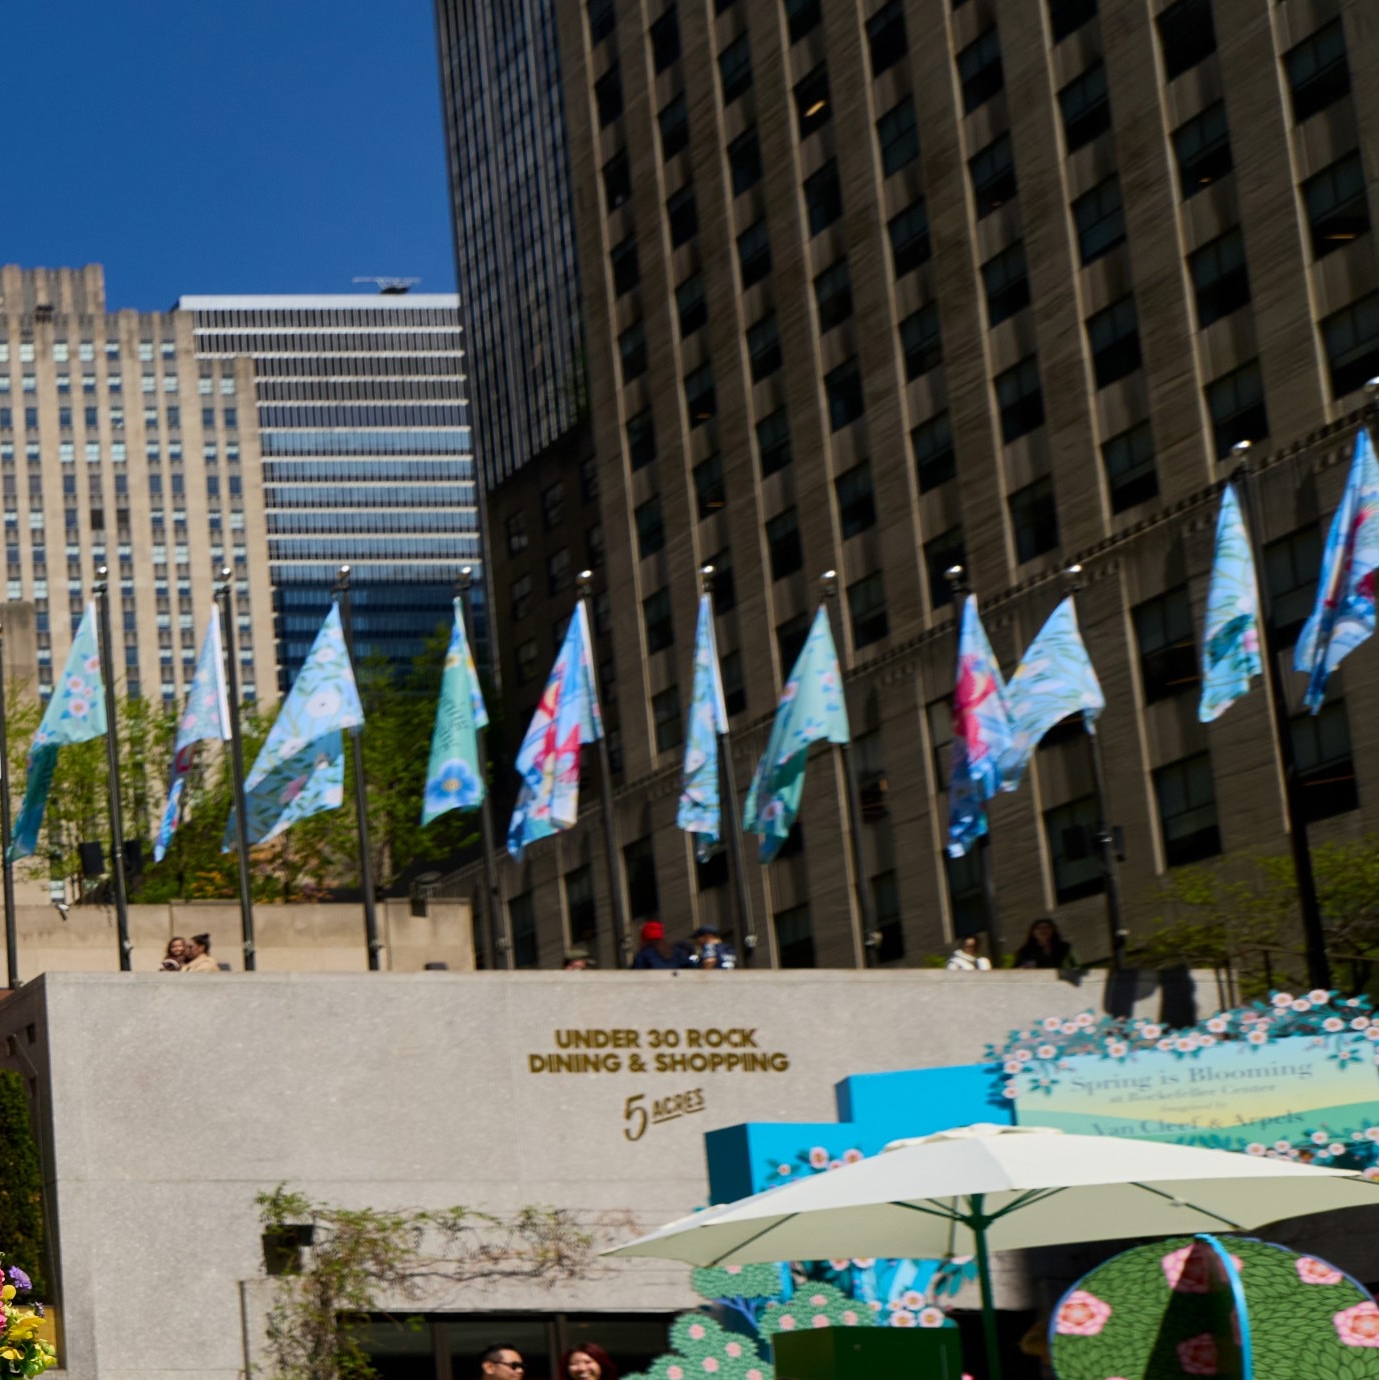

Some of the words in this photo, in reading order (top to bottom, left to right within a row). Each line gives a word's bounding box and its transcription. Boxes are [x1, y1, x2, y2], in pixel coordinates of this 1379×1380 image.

[555, 1028, 640, 1049] UNDER
[647, 1028, 680, 1049] 30
[686, 1028, 759, 1049] ROCK
[528, 1053, 621, 1073] DINING
[628, 1053, 646, 1073] &
[654, 1052, 790, 1073] SHOPPING
[1070, 1067, 1152, 1097] Spring
[1160, 1066, 1181, 1085] is
[1188, 1059, 1315, 1084] Blooming
[622, 1093, 647, 1142] 5
[651, 1087, 706, 1119] ACRES
